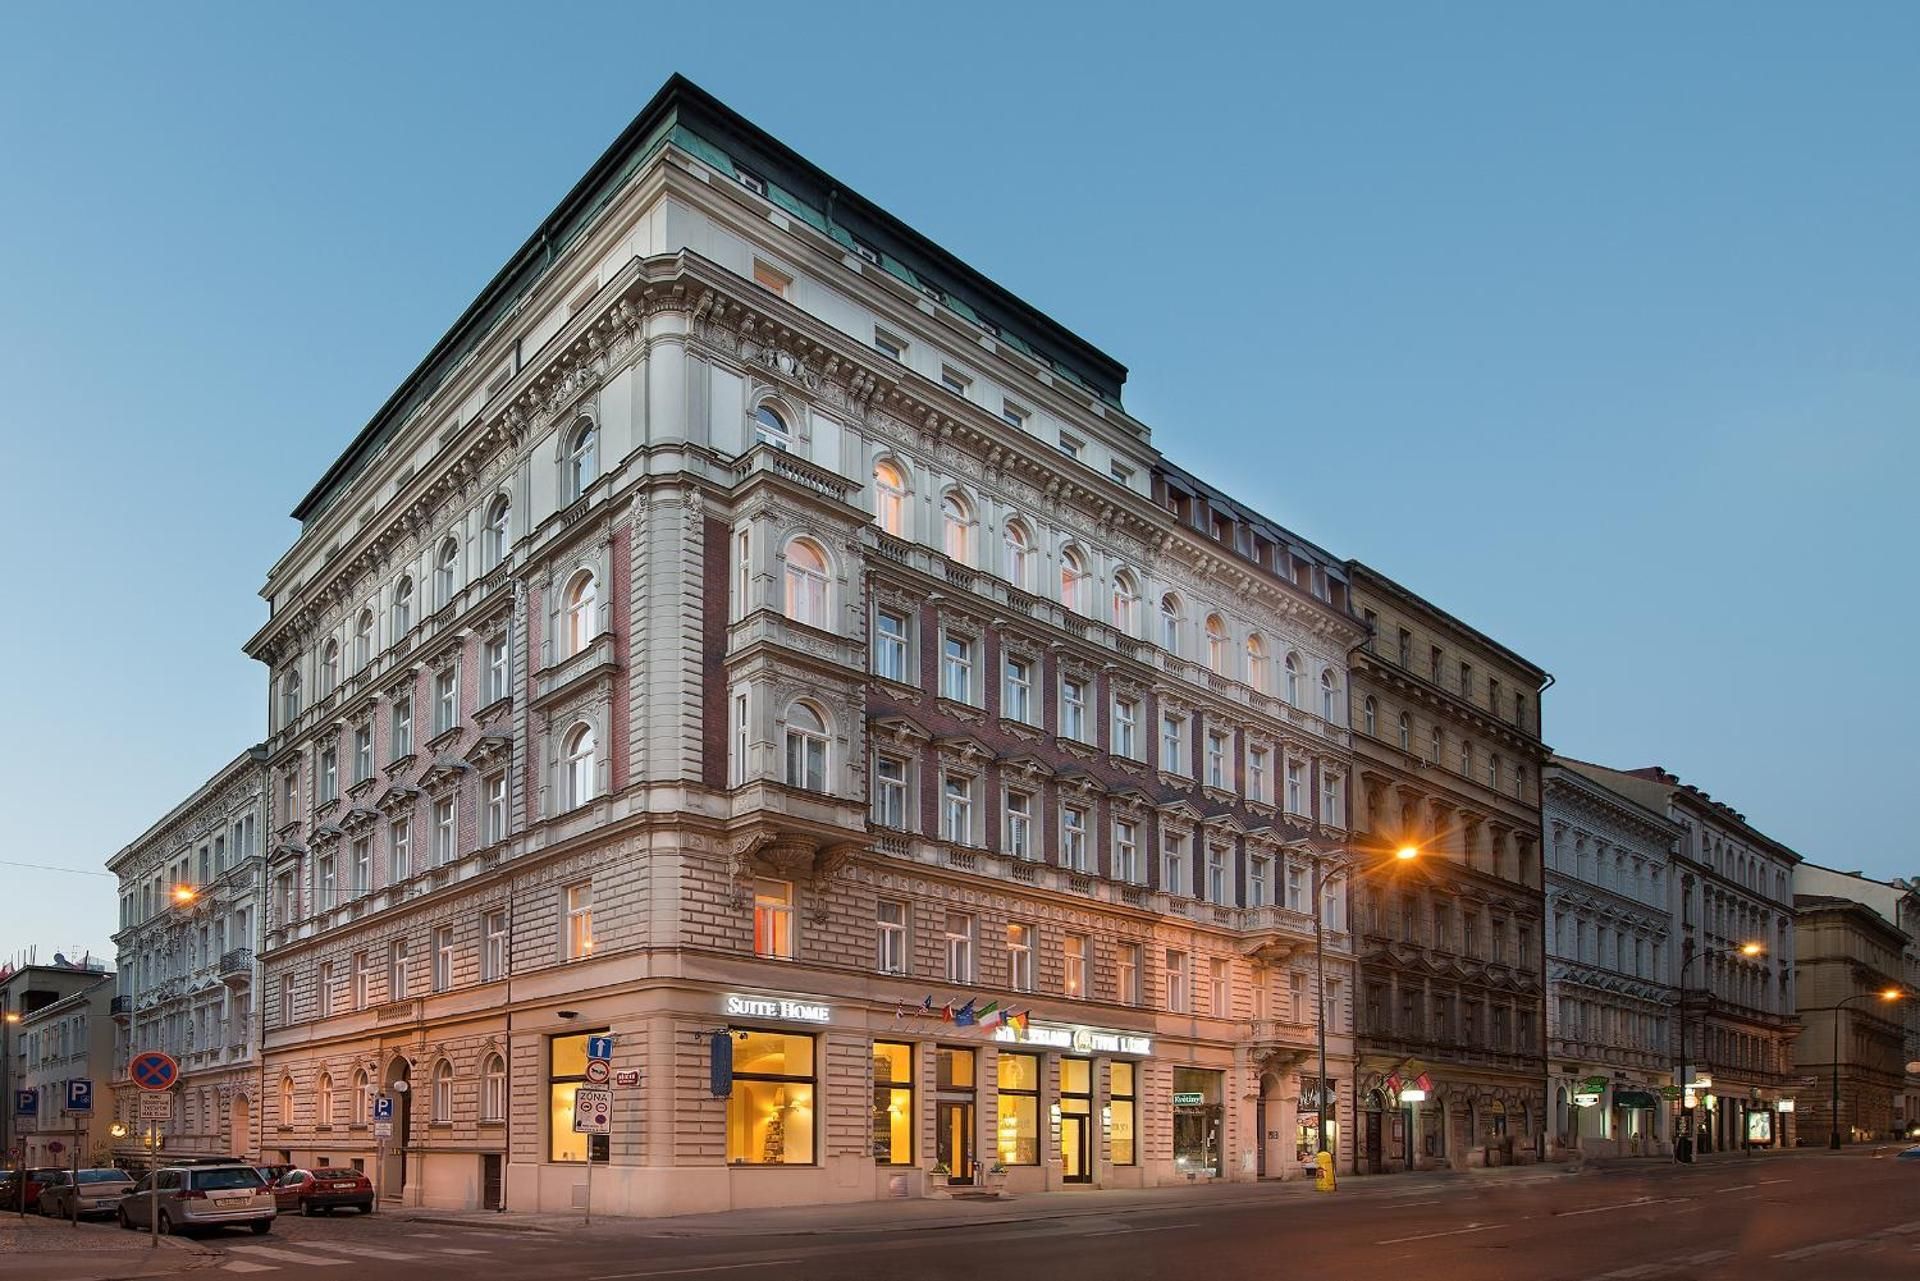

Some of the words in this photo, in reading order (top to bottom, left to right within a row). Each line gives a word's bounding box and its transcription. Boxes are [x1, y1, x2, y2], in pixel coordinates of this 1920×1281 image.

[727, 996, 777, 1016] SUITE
[778, 1001, 830, 1021] HOME
[71, 1083, 87, 1101] P
[20, 1093, 33, 1108] P
[378, 1098, 389, 1112] P
